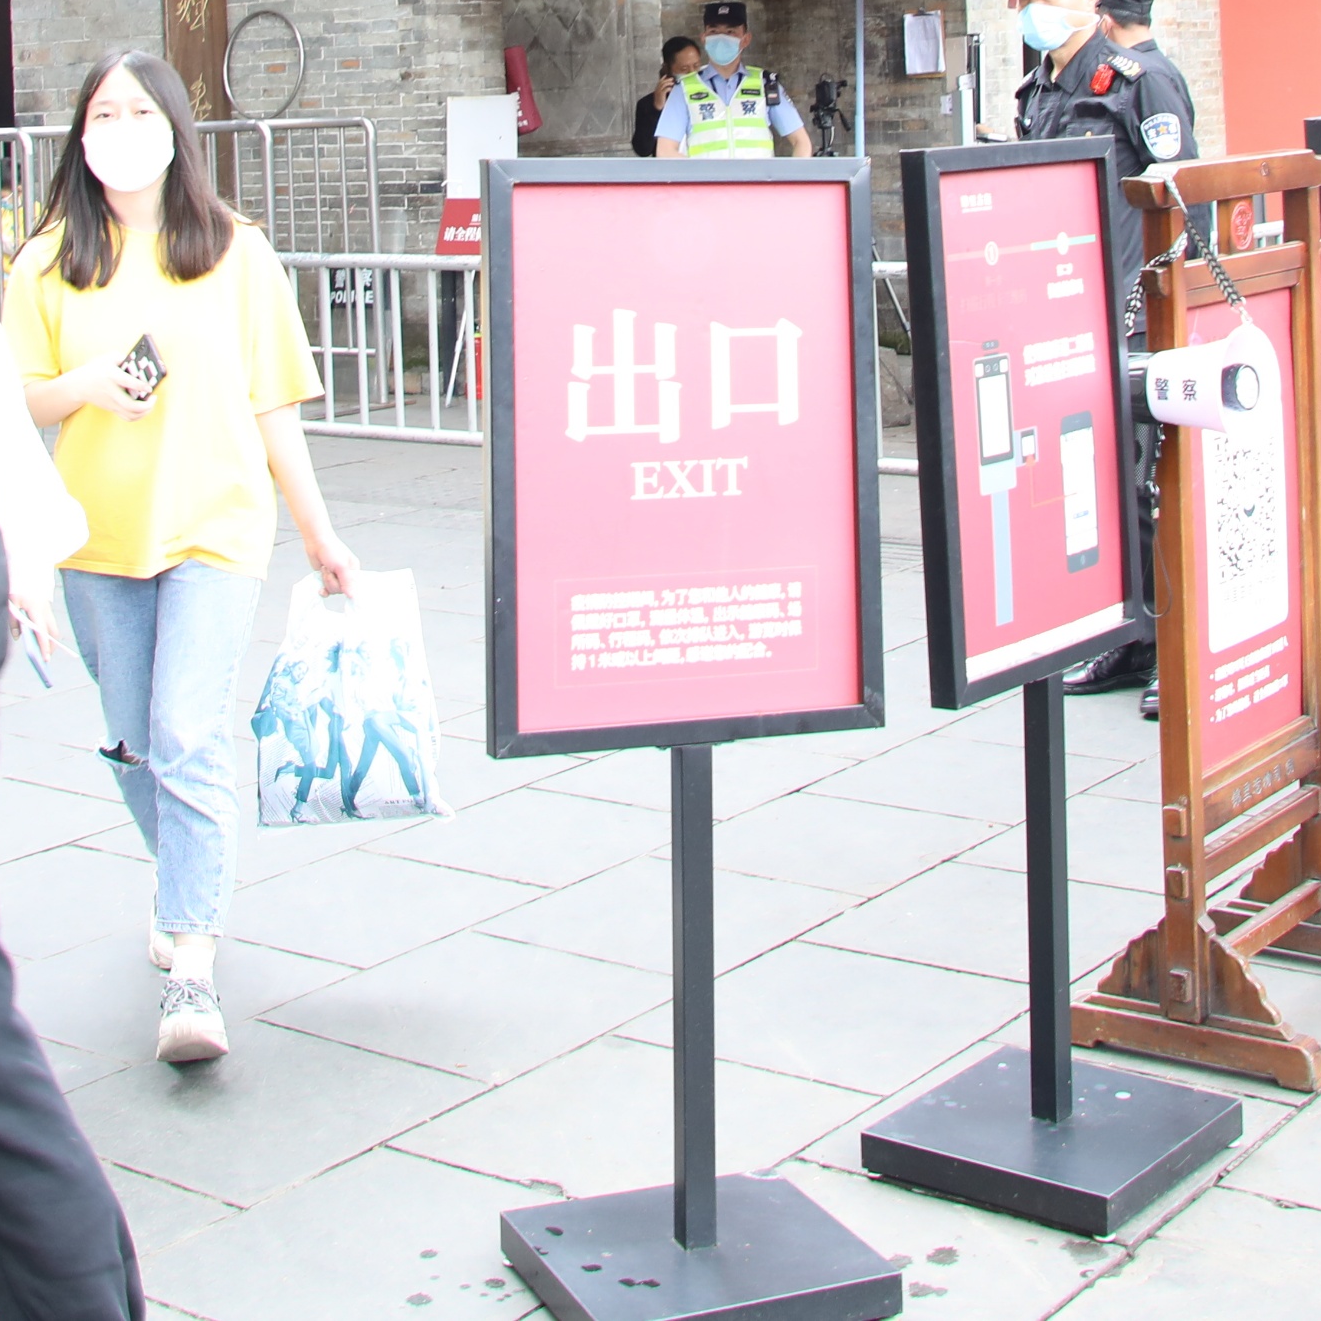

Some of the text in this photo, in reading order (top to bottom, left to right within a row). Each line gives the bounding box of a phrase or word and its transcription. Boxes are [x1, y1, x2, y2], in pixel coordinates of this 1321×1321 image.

[698, 99, 758, 122] 警察
[330, 289, 375, 305] POLIE
[564, 308, 804, 444] 出口
[1154, 377, 1198, 402] 警察
[630, 455, 749, 502] EXIT
